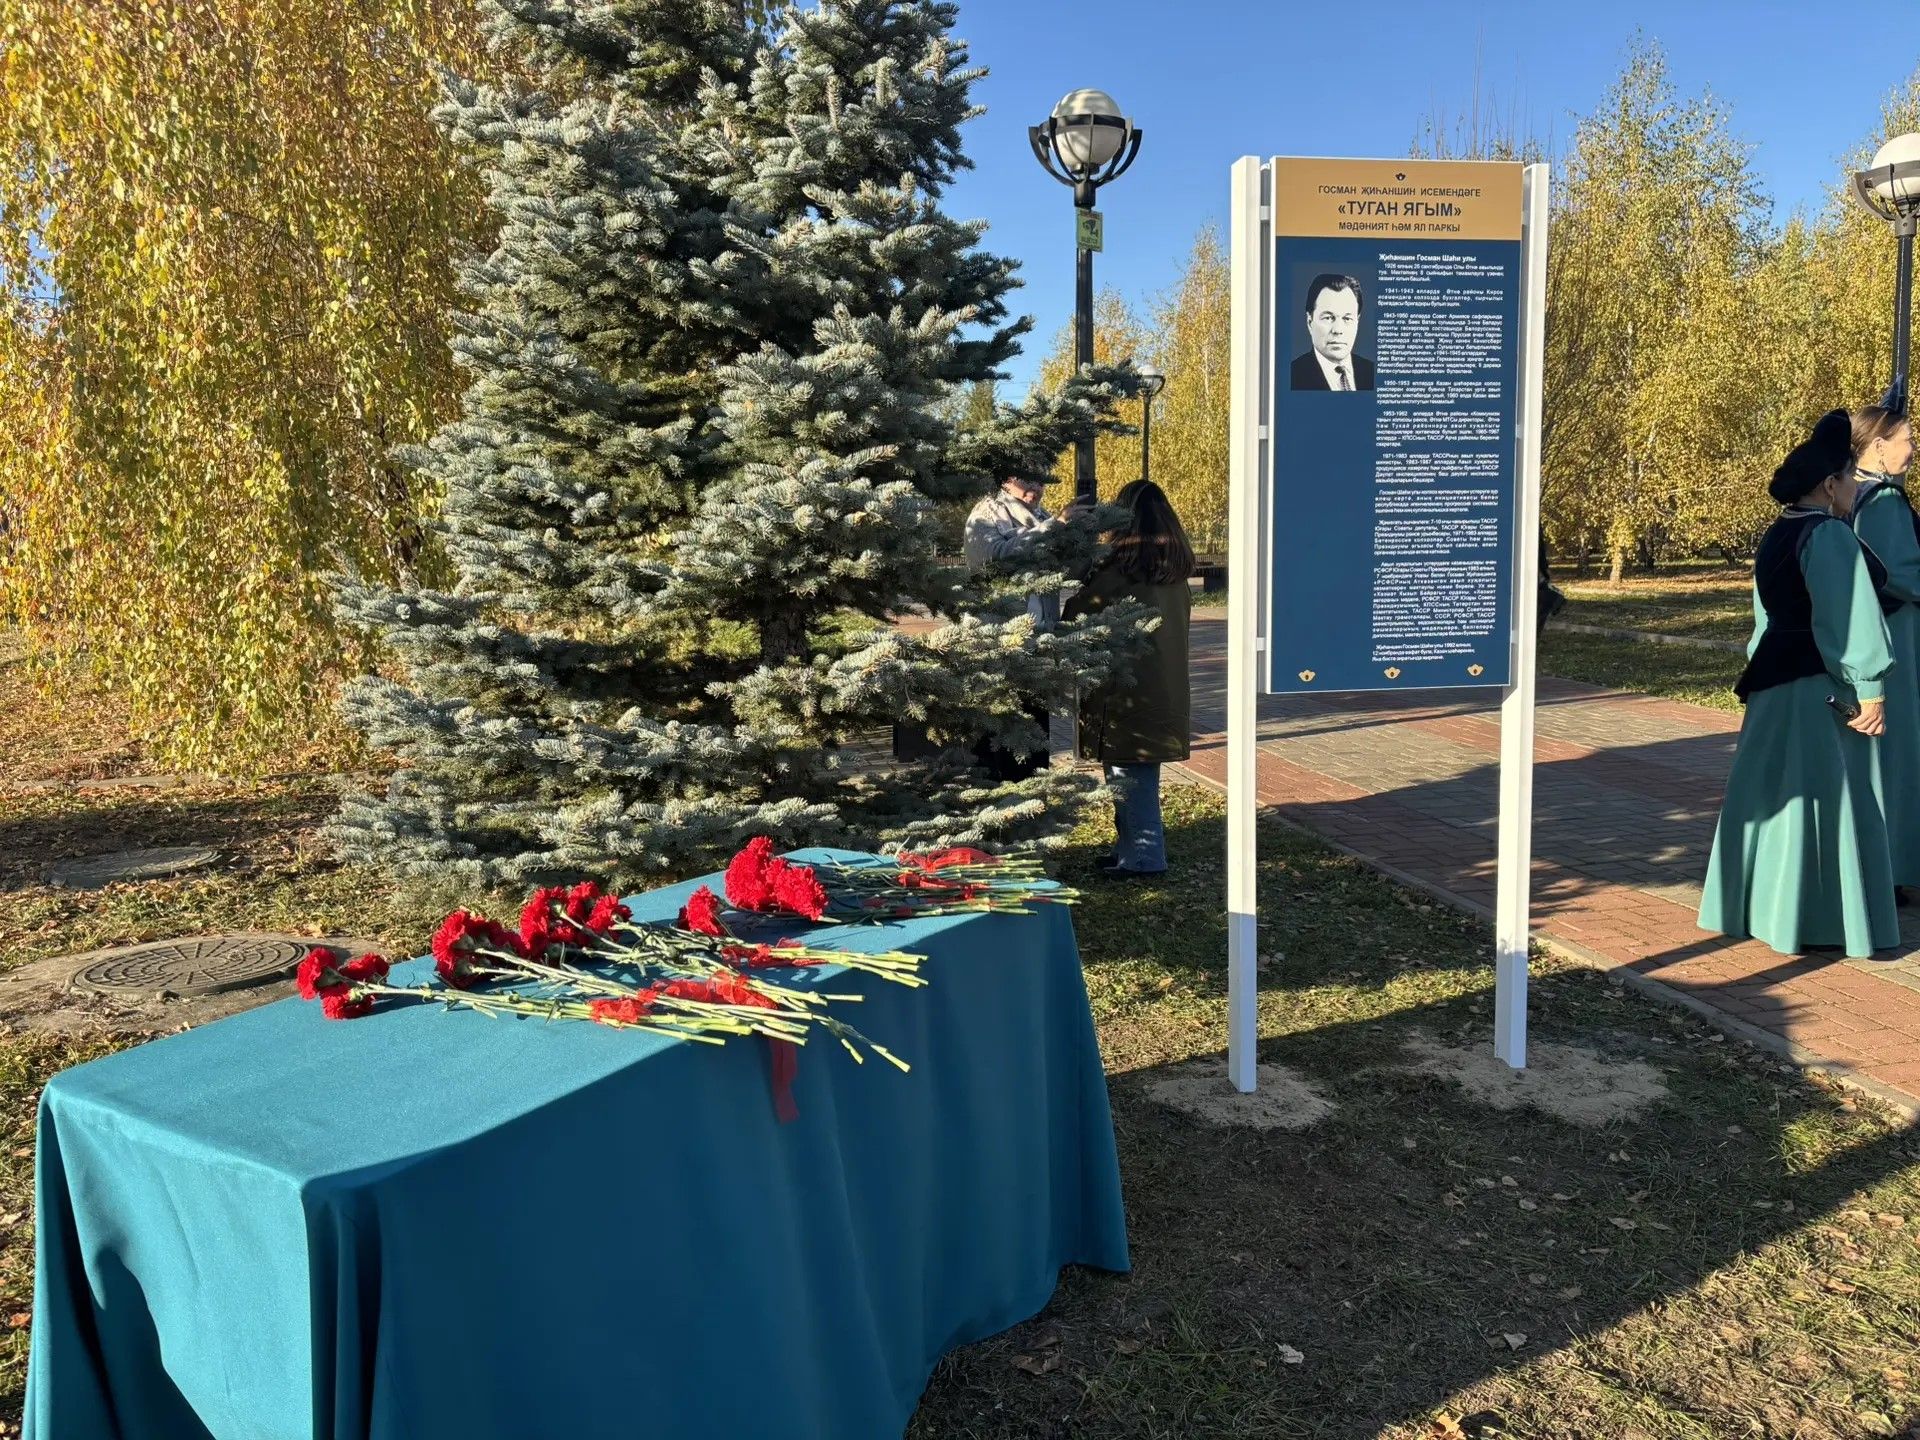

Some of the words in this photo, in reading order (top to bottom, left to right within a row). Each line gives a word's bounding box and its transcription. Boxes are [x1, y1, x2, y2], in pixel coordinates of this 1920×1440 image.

[1319, 186, 1356, 195] ГОСМАН
[1361, 186, 1415, 196] ҖИҺАНШИН
[1421, 188, 1480, 197] ИСЕМЕНДӘГЕ
[1338, 201, 1398, 215] «ТУГАН
[1404, 202, 1461, 217] ЯГЫМ»
[1339, 222, 1389, 231] МӘДӘНИЯТ
[1392, 223, 1411, 231] ҺӘМ
[1428, 224, 1460, 232] ПАРКЫ
